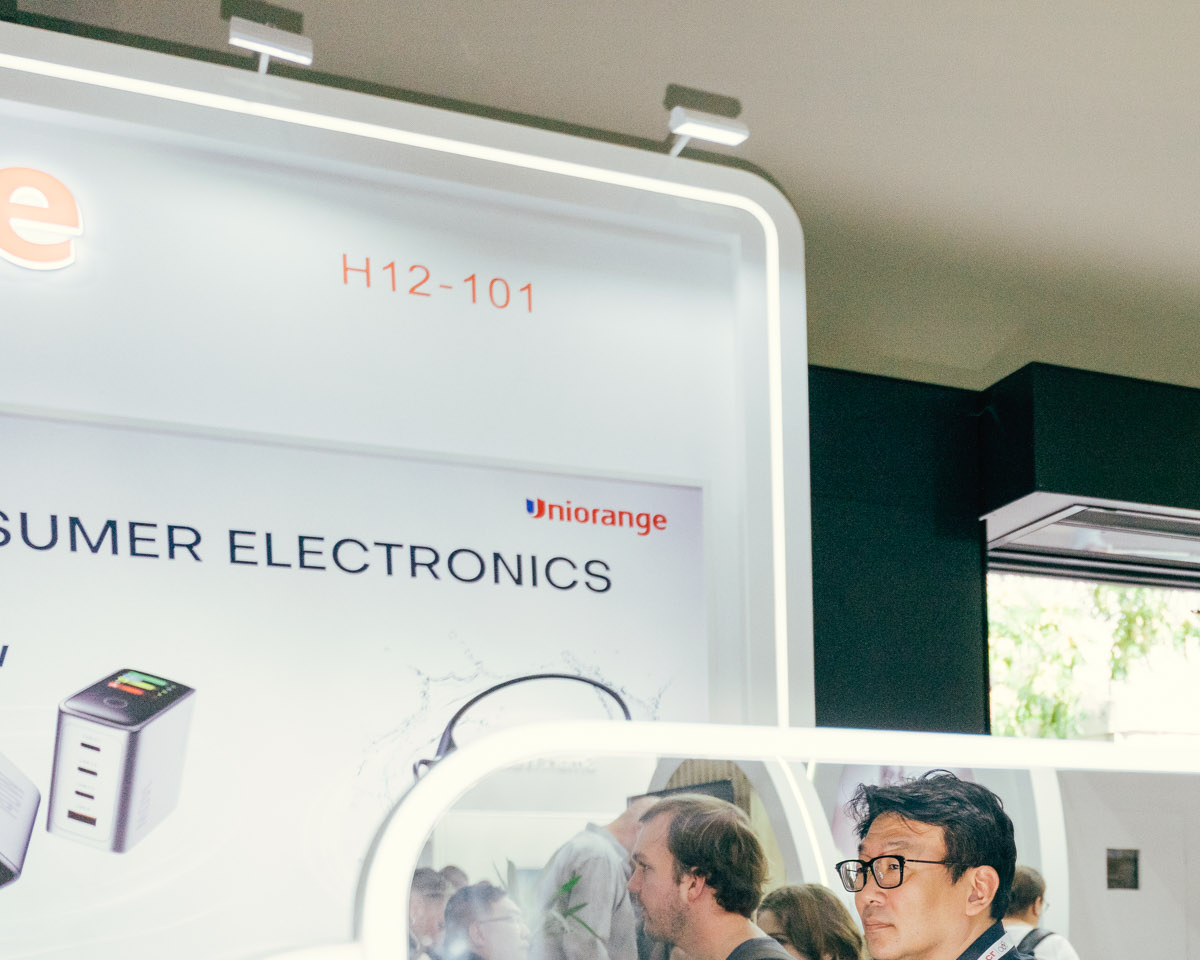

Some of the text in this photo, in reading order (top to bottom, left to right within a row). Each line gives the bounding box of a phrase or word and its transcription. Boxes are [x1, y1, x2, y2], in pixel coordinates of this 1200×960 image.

[343, 253, 532, 313] H12-101
[526, 498, 667, 536] Uniorange
[228, 529, 612, 593] ELECTRONICS
